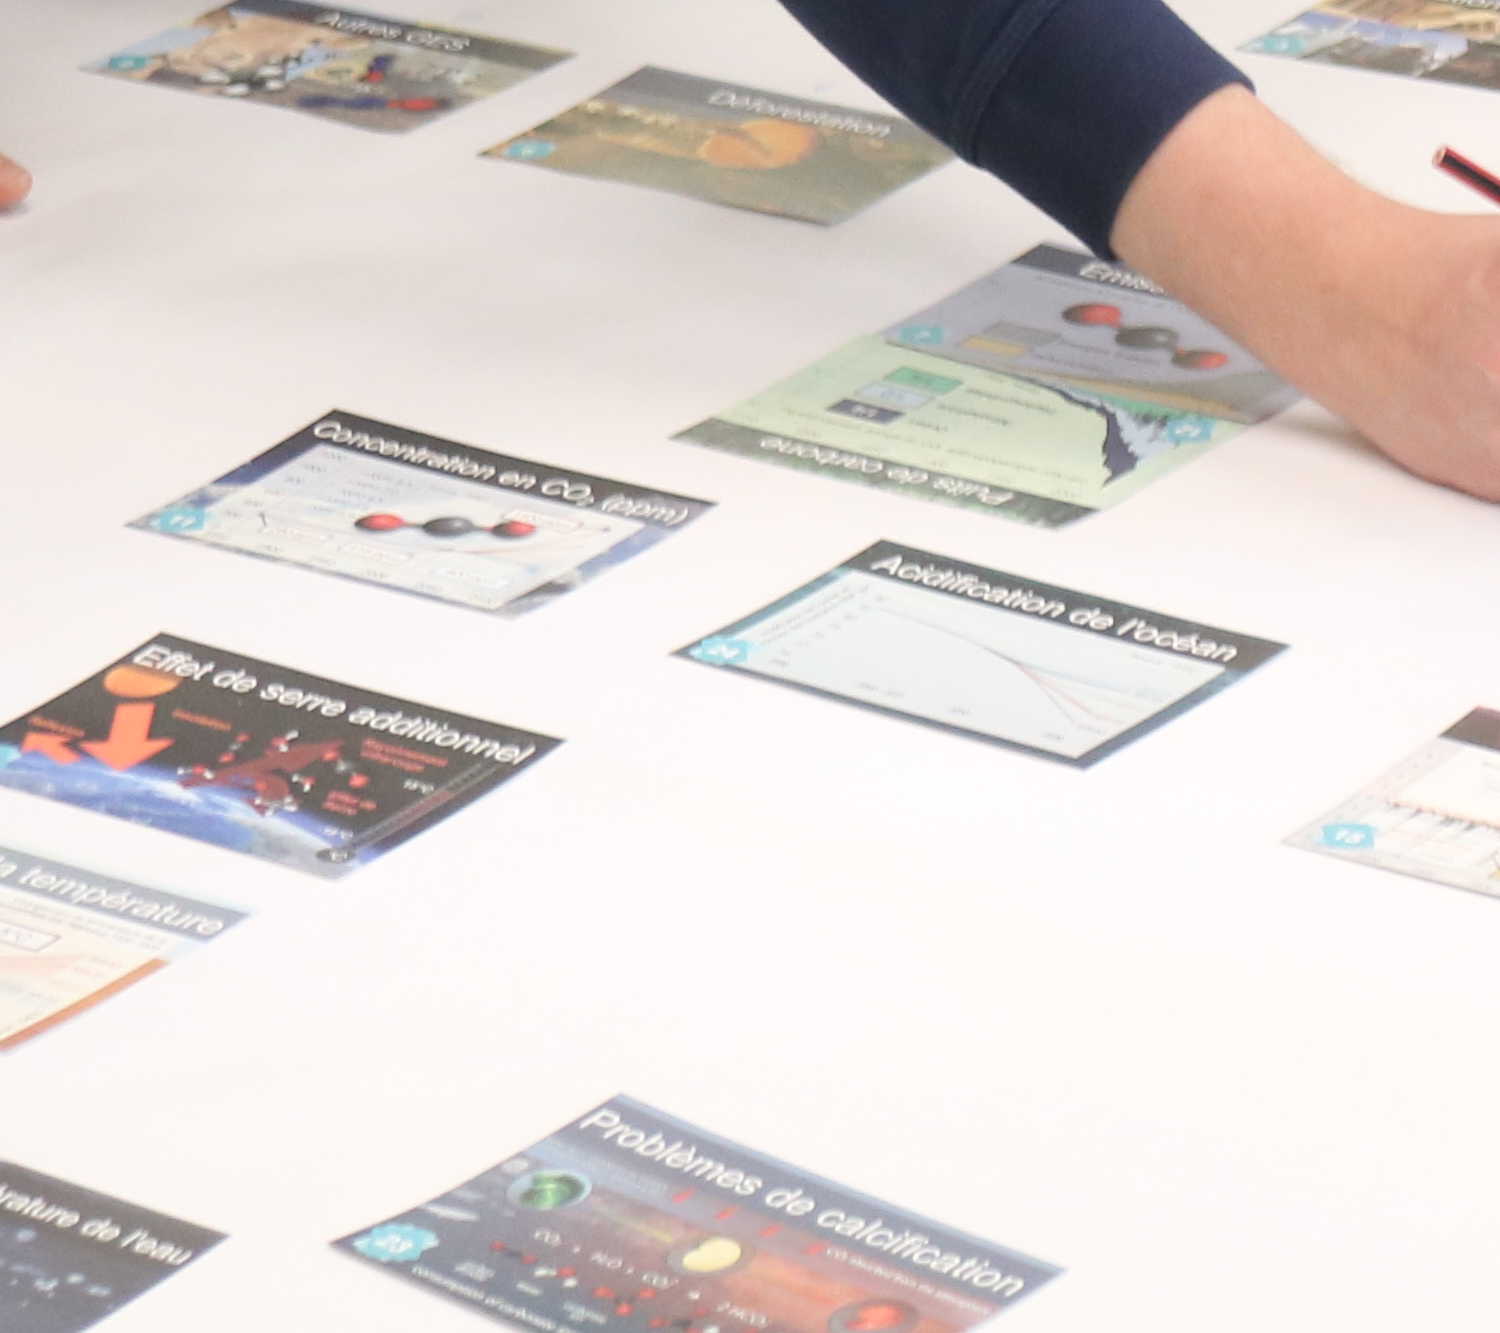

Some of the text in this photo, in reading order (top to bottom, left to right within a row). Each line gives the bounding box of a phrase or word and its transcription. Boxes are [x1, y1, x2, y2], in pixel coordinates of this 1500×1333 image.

[313, 419, 498, 483] Concentration
[498, 465, 538, 492] en
[600, 493, 690, 527] (ppm)
[870, 554, 1065, 618] Acidification
[1069, 605, 1114, 633] de
[132, 643, 213, 683] Effet
[213, 662, 258, 696] de
[258, 679, 349, 718] serre
[347, 698, 536, 766] additionnel
[20, 862, 226, 937] température
[79, 1214, 122, 1243] de
[120, 1226, 193, 1269] l'eau
[578, 1106, 765, 1200] Problèmes
[764, 1179, 817, 1217] de
[814, 1198, 1029, 1298] calcification
